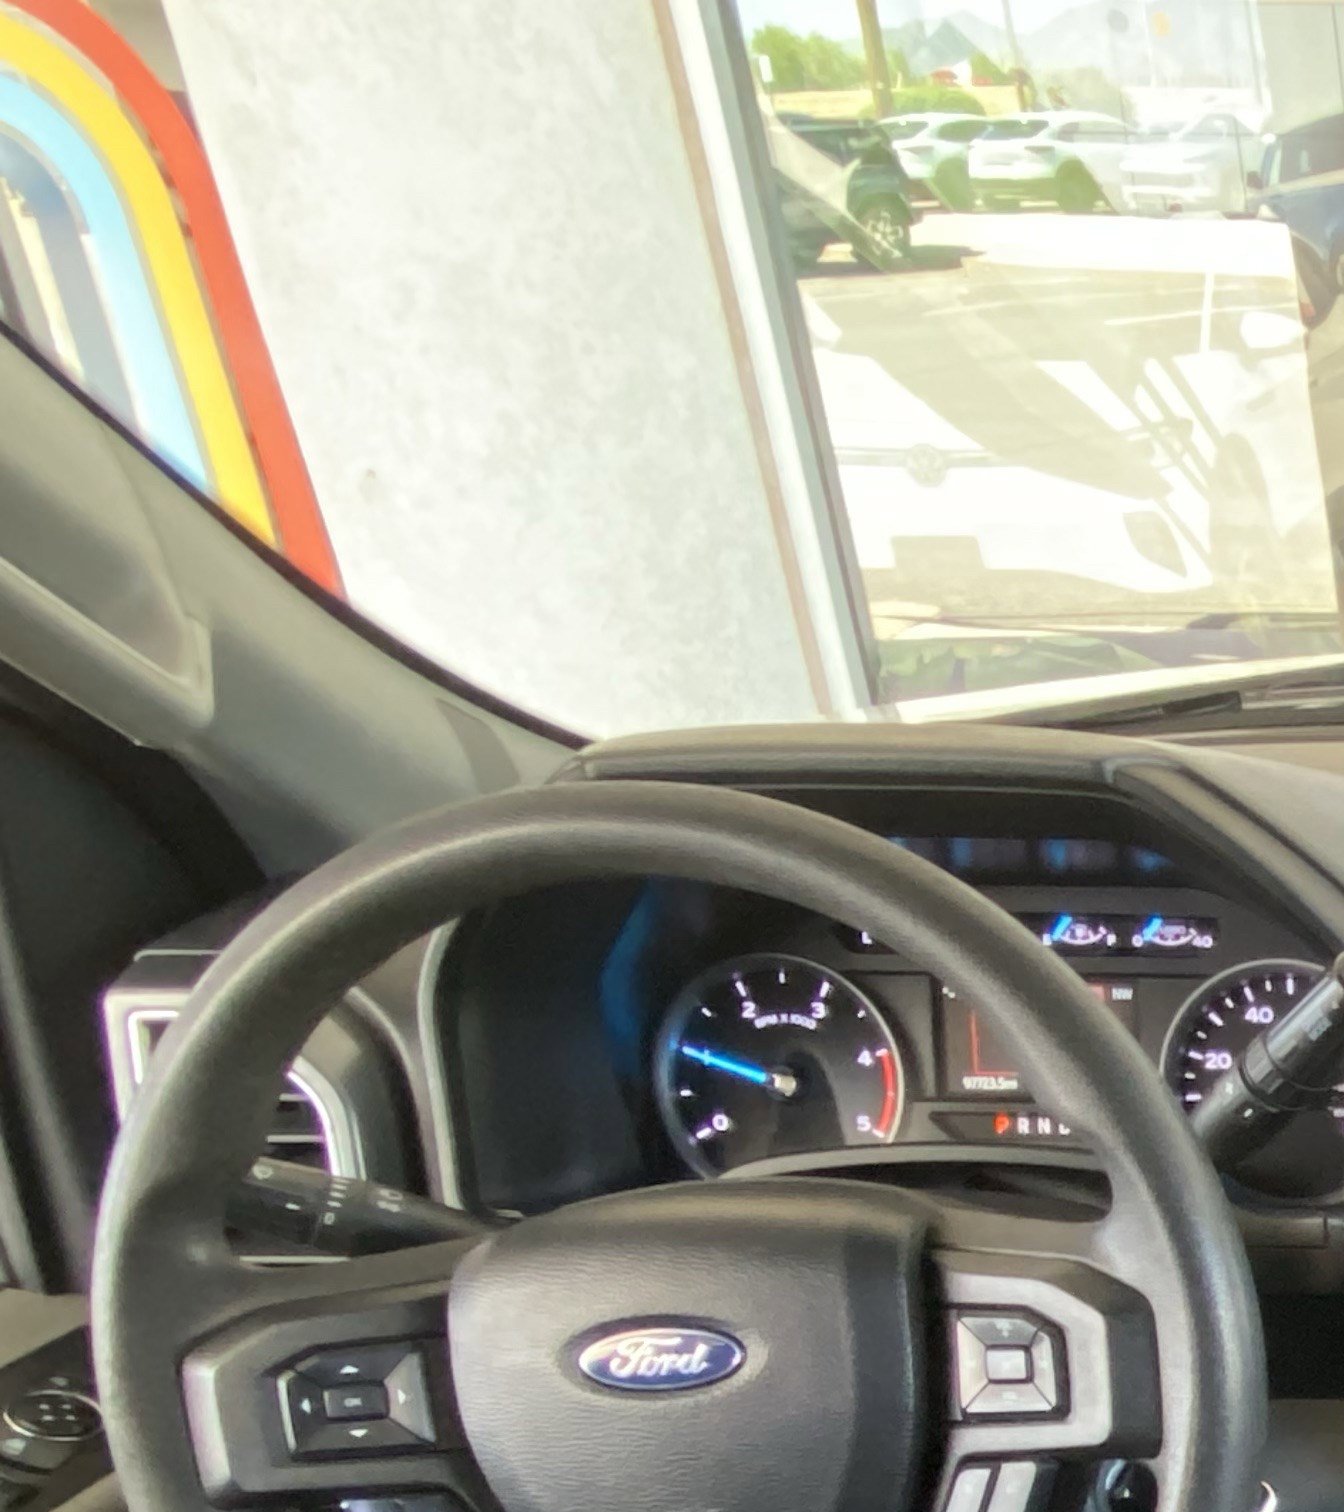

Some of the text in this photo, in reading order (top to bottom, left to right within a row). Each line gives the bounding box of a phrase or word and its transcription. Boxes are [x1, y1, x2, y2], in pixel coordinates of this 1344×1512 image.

[740, 1001, 757, 1019] 2
[811, 1001, 827, 1019] 3
[1243, 1006, 1275, 1025] 40
[856, 1049, 874, 1067] 4
[1203, 1052, 1233, 1070] 20
[712, 1113, 730, 1131] 0
[856, 1115, 872, 1132] 5
[994, 1111, 1010, 1134] P
[1017, 1116, 1031, 1134] R
[1037, 1116, 1051, 1134] N
[609, 1336, 710, 1378] Ford
